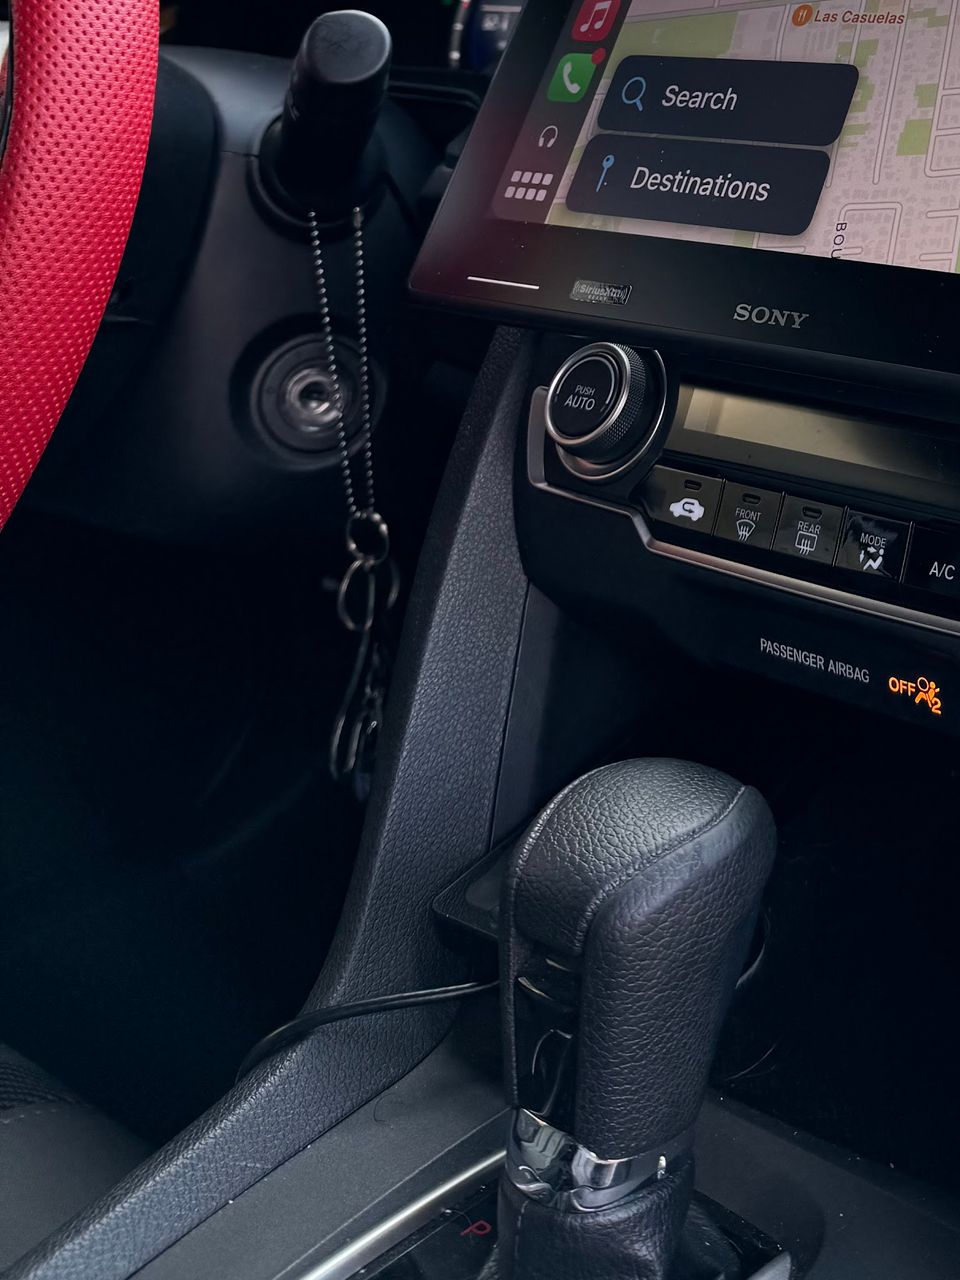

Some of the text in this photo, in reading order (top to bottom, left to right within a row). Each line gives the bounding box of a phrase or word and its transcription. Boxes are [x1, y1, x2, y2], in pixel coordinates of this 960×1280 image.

[814, 9, 905, 25] Las Casuelas
[661, 85, 738, 111] Search
[630, 166, 771, 202] Destinations
[733, 303, 810, 329] SONY
[574, 385, 596, 396] PUSH
[564, 394, 596, 411] AUTO
[735, 507, 763, 521] FRONT
[797, 520, 822, 535] REAR
[859, 532, 887, 549] MODE
[928, 561, 956, 581] A/C
[760, 638, 870, 684] PASSENGER AIRBAG
[888, 676, 916, 697] OFF
